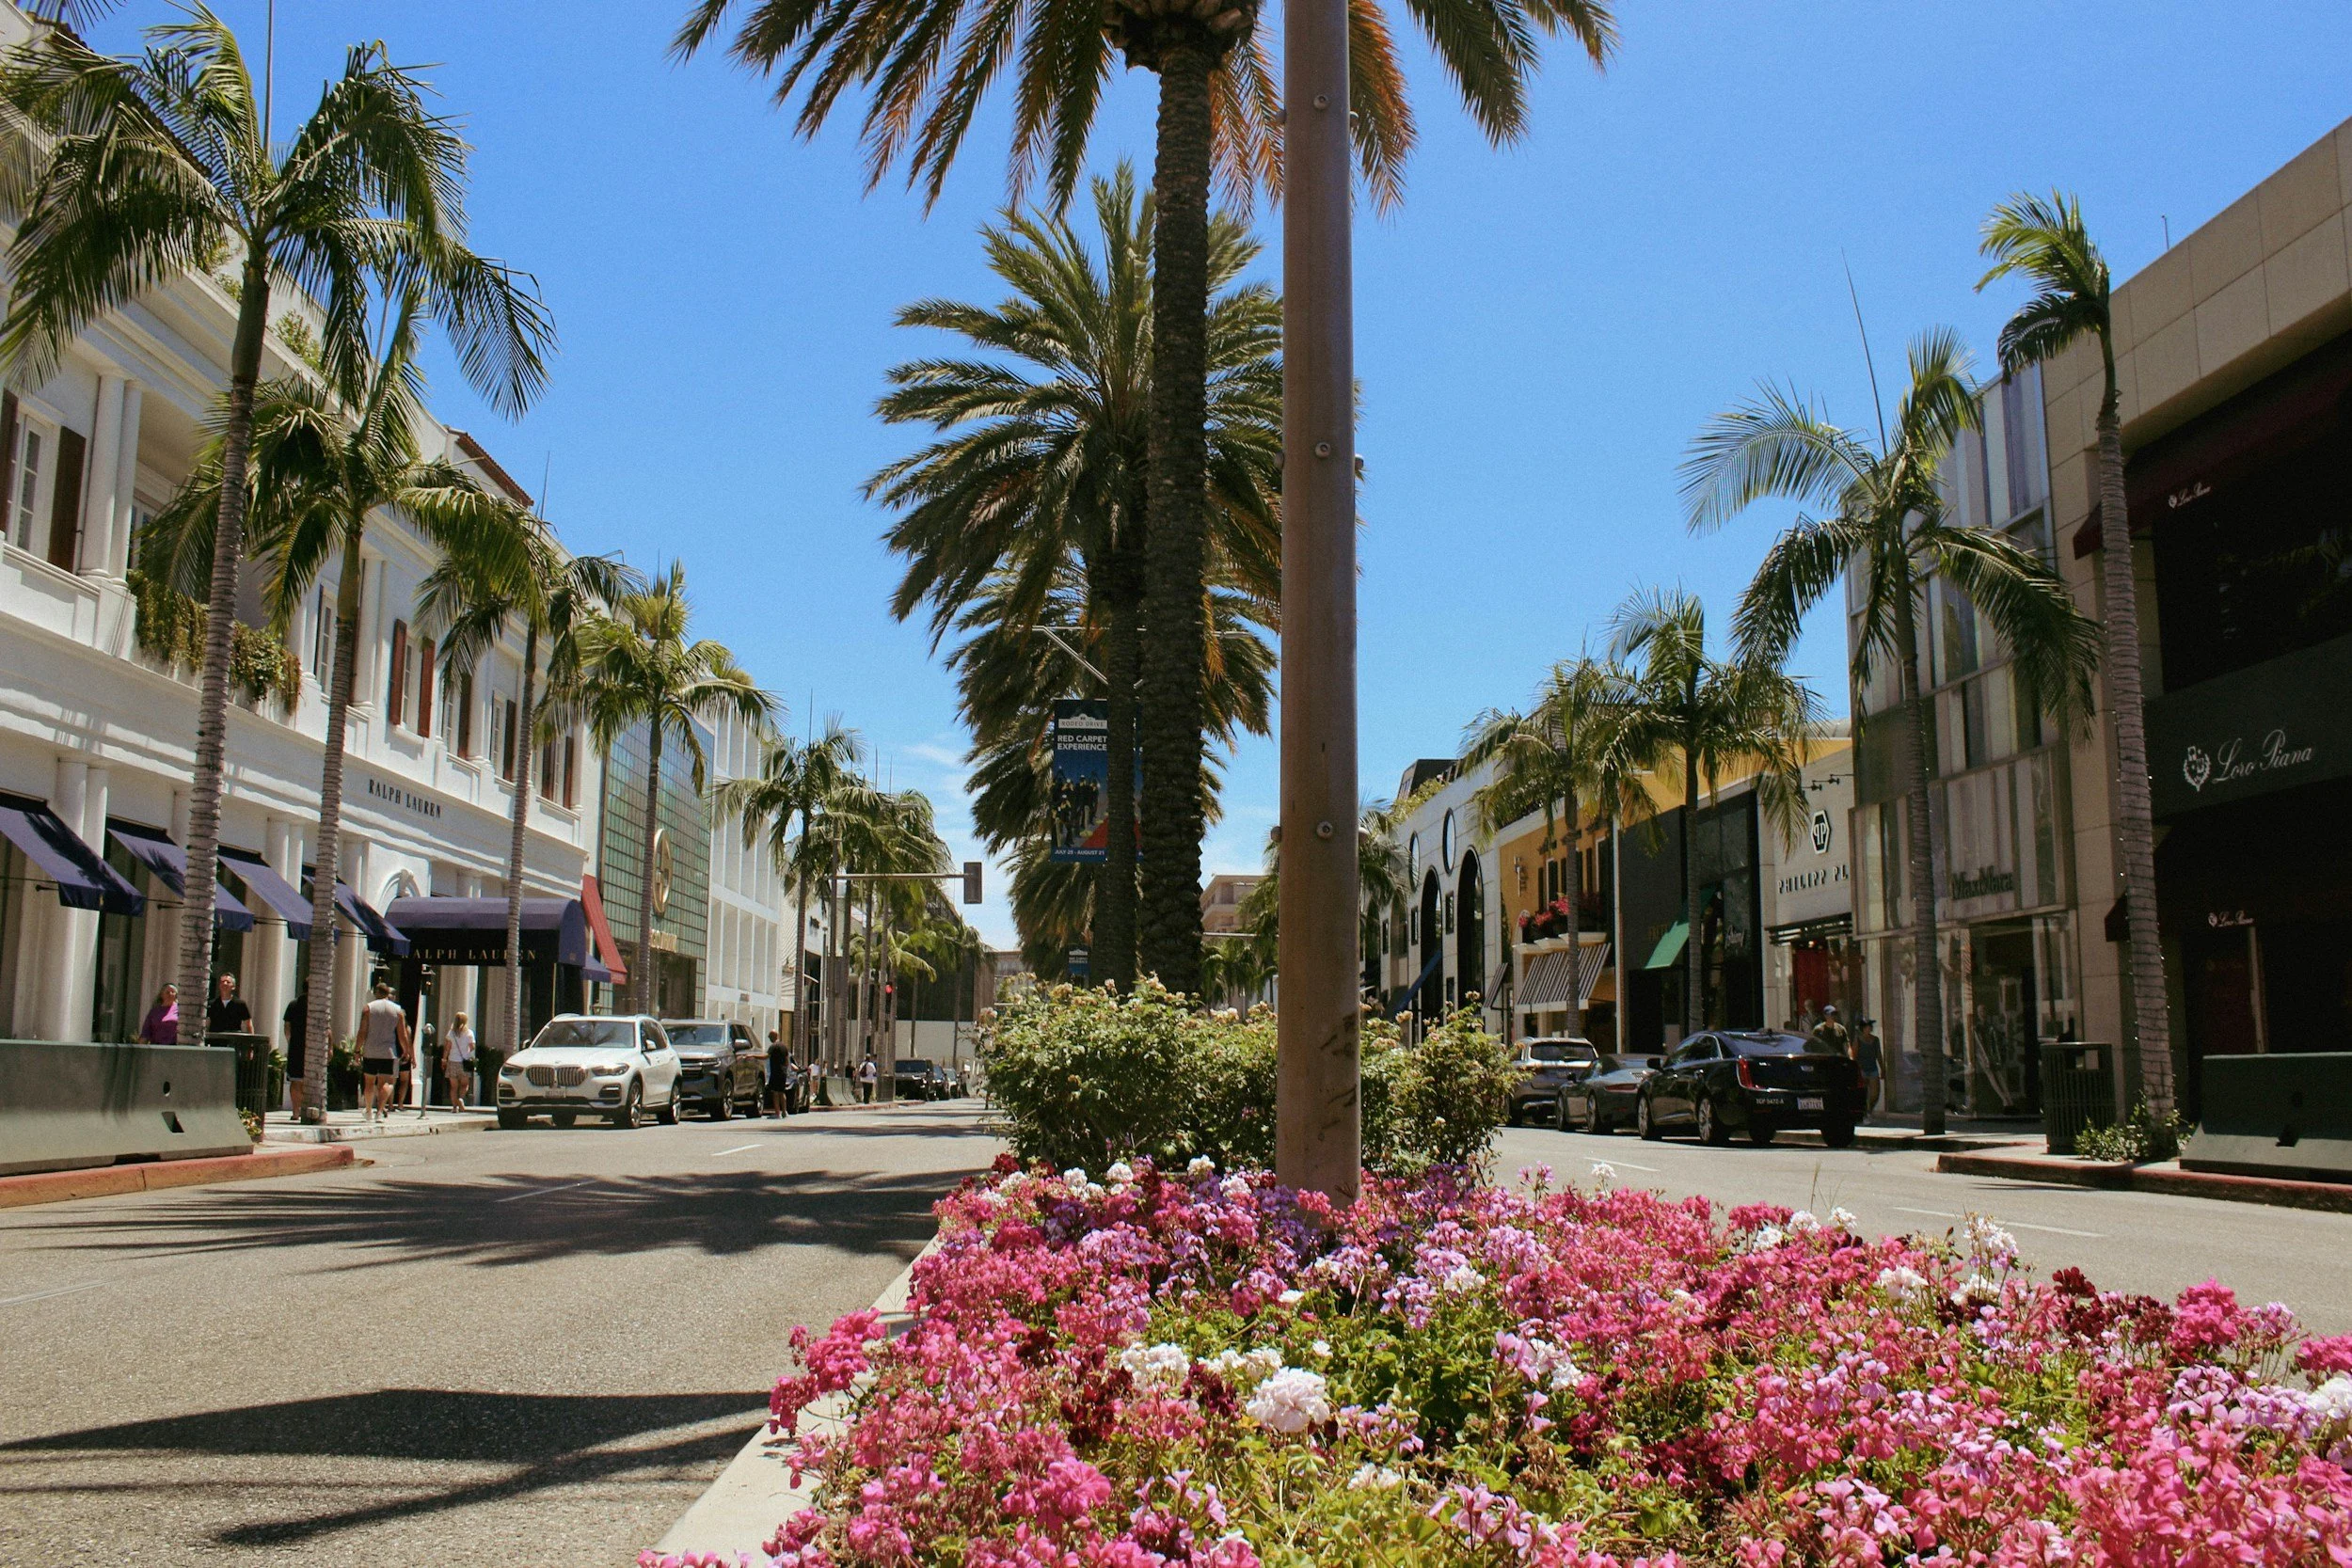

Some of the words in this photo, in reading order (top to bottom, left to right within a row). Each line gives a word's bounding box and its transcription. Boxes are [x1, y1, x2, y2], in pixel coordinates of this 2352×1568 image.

[2212, 737, 2255, 784] Loro
[2260, 729, 2312, 770] Piana
[369, 779, 401, 804] RALPH
[406, 793, 441, 818] LAUREN
[1777, 869, 1826, 894] PHILIPP
